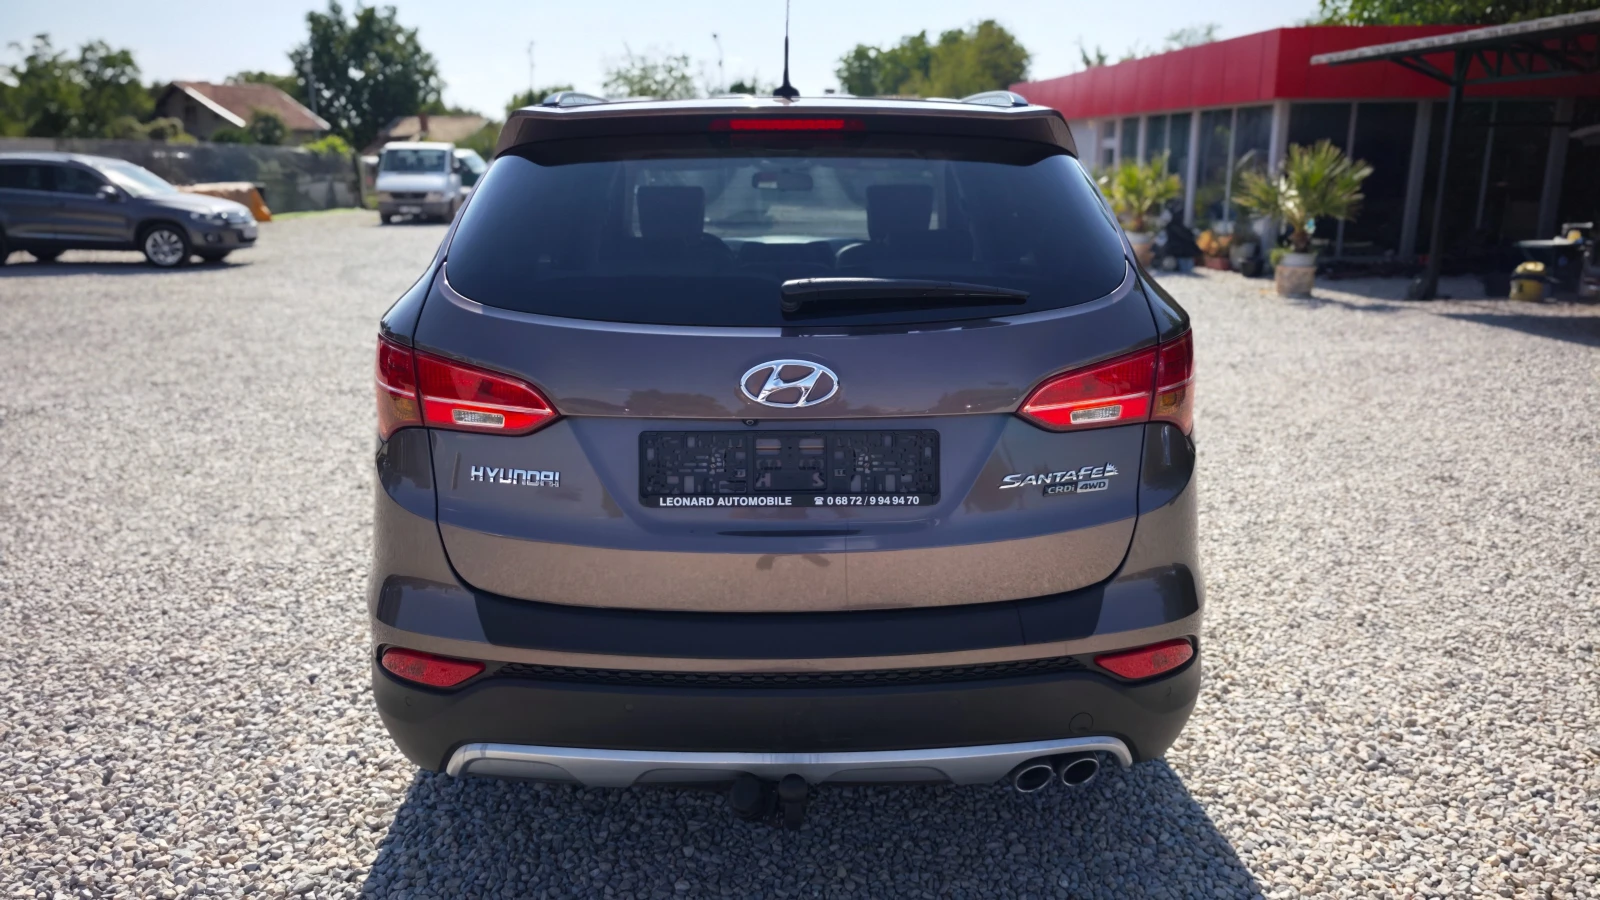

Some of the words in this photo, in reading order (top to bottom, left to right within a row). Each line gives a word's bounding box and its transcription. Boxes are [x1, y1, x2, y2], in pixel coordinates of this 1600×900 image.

[470, 465, 560, 488] HYUNDAI
[1079, 481, 1107, 491] 4WD
[660, 497, 714, 506] LEONARD
[717, 497, 792, 506] AUTOMOBILE
